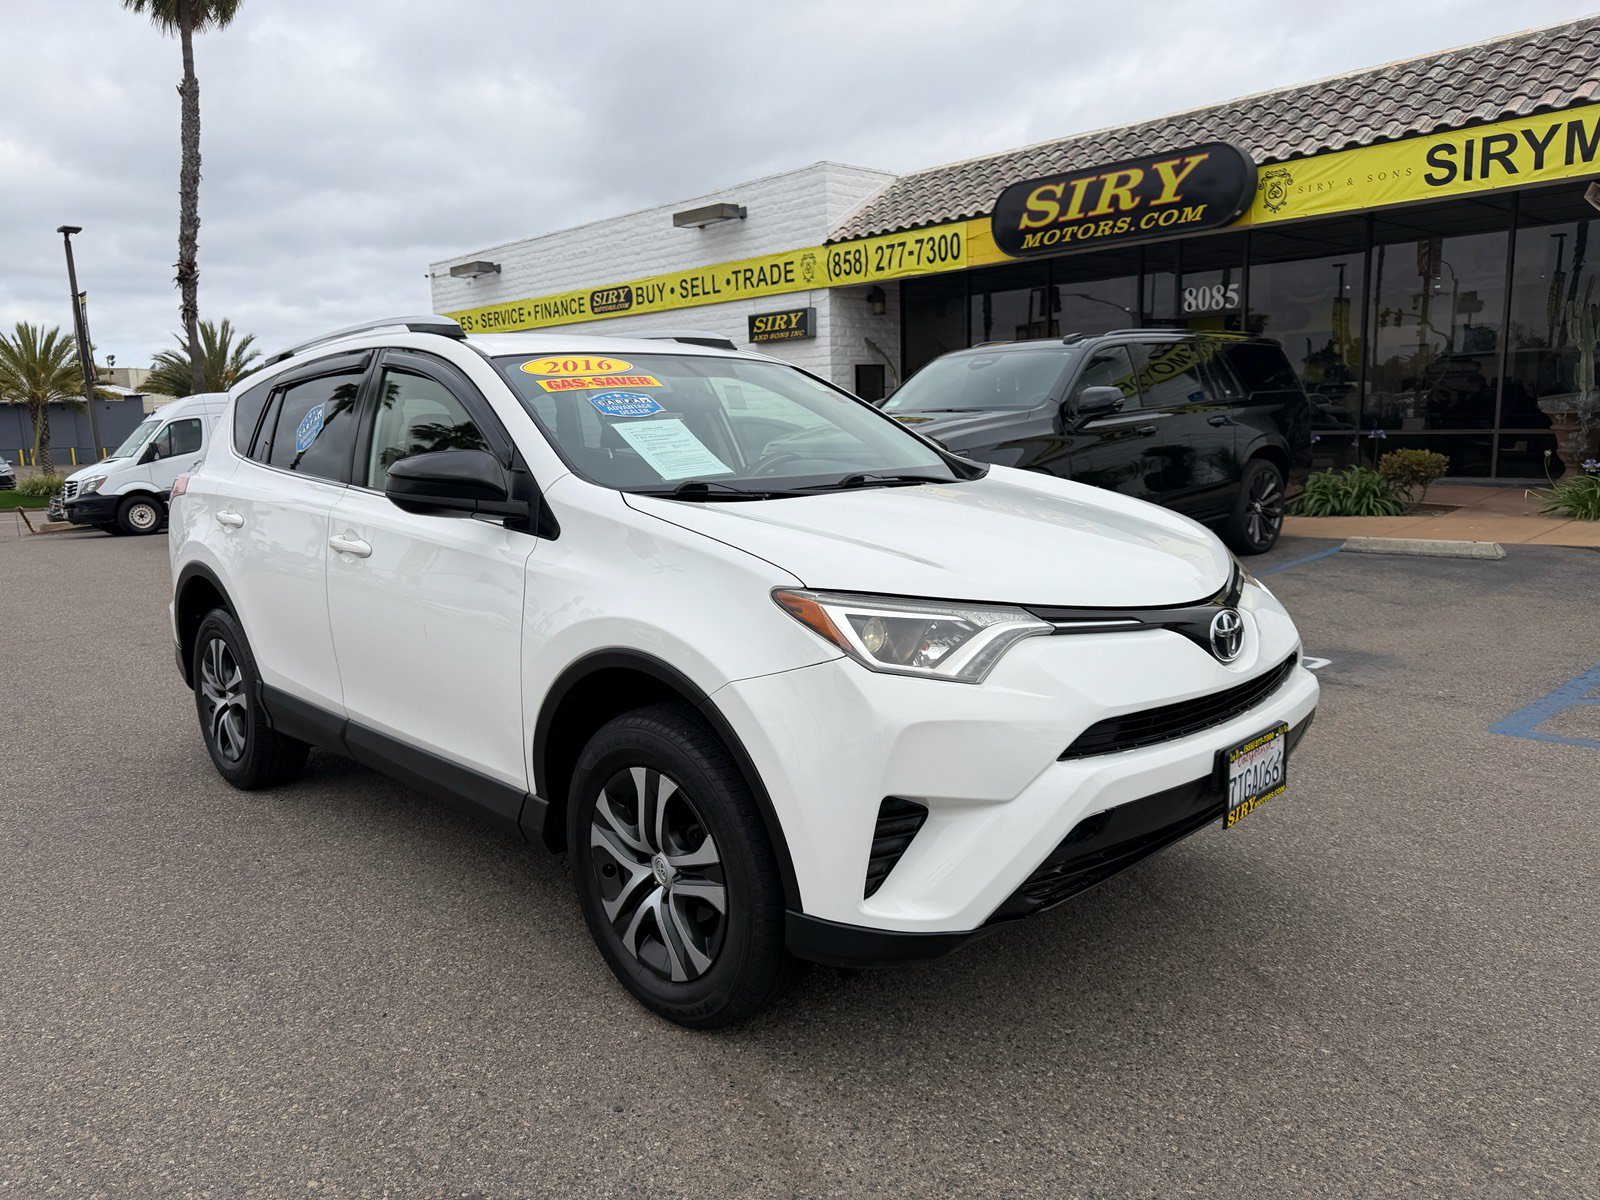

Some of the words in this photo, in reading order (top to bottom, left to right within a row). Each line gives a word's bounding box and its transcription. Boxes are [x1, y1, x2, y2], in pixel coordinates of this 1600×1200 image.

[1018, 153, 1210, 230] SIRY
[1297, 179, 1335, 194] SIRY
[1346, 177, 1354, 186] &
[1367, 167, 1413, 183] SONS
[1020, 204, 1207, 249] MOTORS.COM
[827, 244, 868, 281] (858)
[875, 232, 961, 272] 277-7300
[593, 287, 630, 307] SIRY
[636, 283, 667, 305] BUY
[680, 274, 721, 299] SELL
[732, 261, 795, 291] TRADE
[1184, 283, 1240, 312] 8085
[480, 307, 525, 329] SERVICE
[534, 297, 585, 320] FINANCE
[753, 312, 804, 333] SIRY
[544, 359, 613, 374] 2016
[546, 376, 655, 391] GAS-SAVER
[607, 403, 654, 411] ADVANTAGE
[1227, 796, 1256, 828] SIRY
